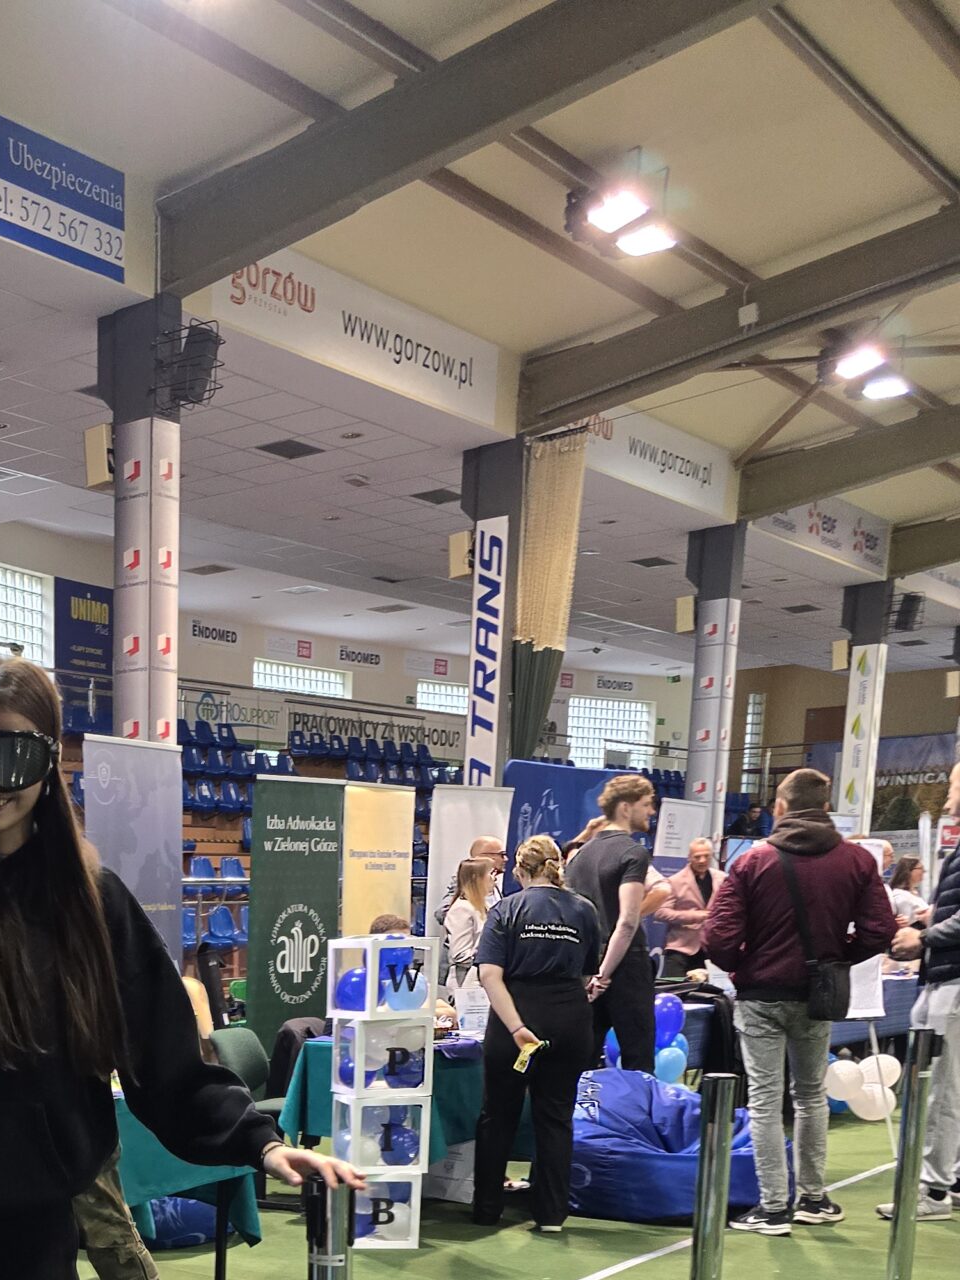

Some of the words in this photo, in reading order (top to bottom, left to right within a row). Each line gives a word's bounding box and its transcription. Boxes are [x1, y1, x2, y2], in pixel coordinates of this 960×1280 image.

[8, 136, 125, 213] Ubezpieczenia
[20, 194, 53, 236] 572
[58, 211, 89, 247] 567
[94, 224, 125, 263] 332
[341, 309, 474, 390] www.gorzow.pl
[627, 435, 713, 489] www.gorzow.pl
[191, 624, 238, 644] ENDOMED
[471, 529, 503, 737] TRANS
[339, 649, 381, 666] ENDOMED
[266, 813, 286, 831] Izba
[286, 814, 337, 832] Adwokacka
[263, 840, 272, 852] w
[273, 836, 310, 857] Zielonej
[310, 836, 339, 853] Górze
[385, 963, 424, 993] W
[385, 1047, 410, 1077] P
[370, 1197, 396, 1226] B
